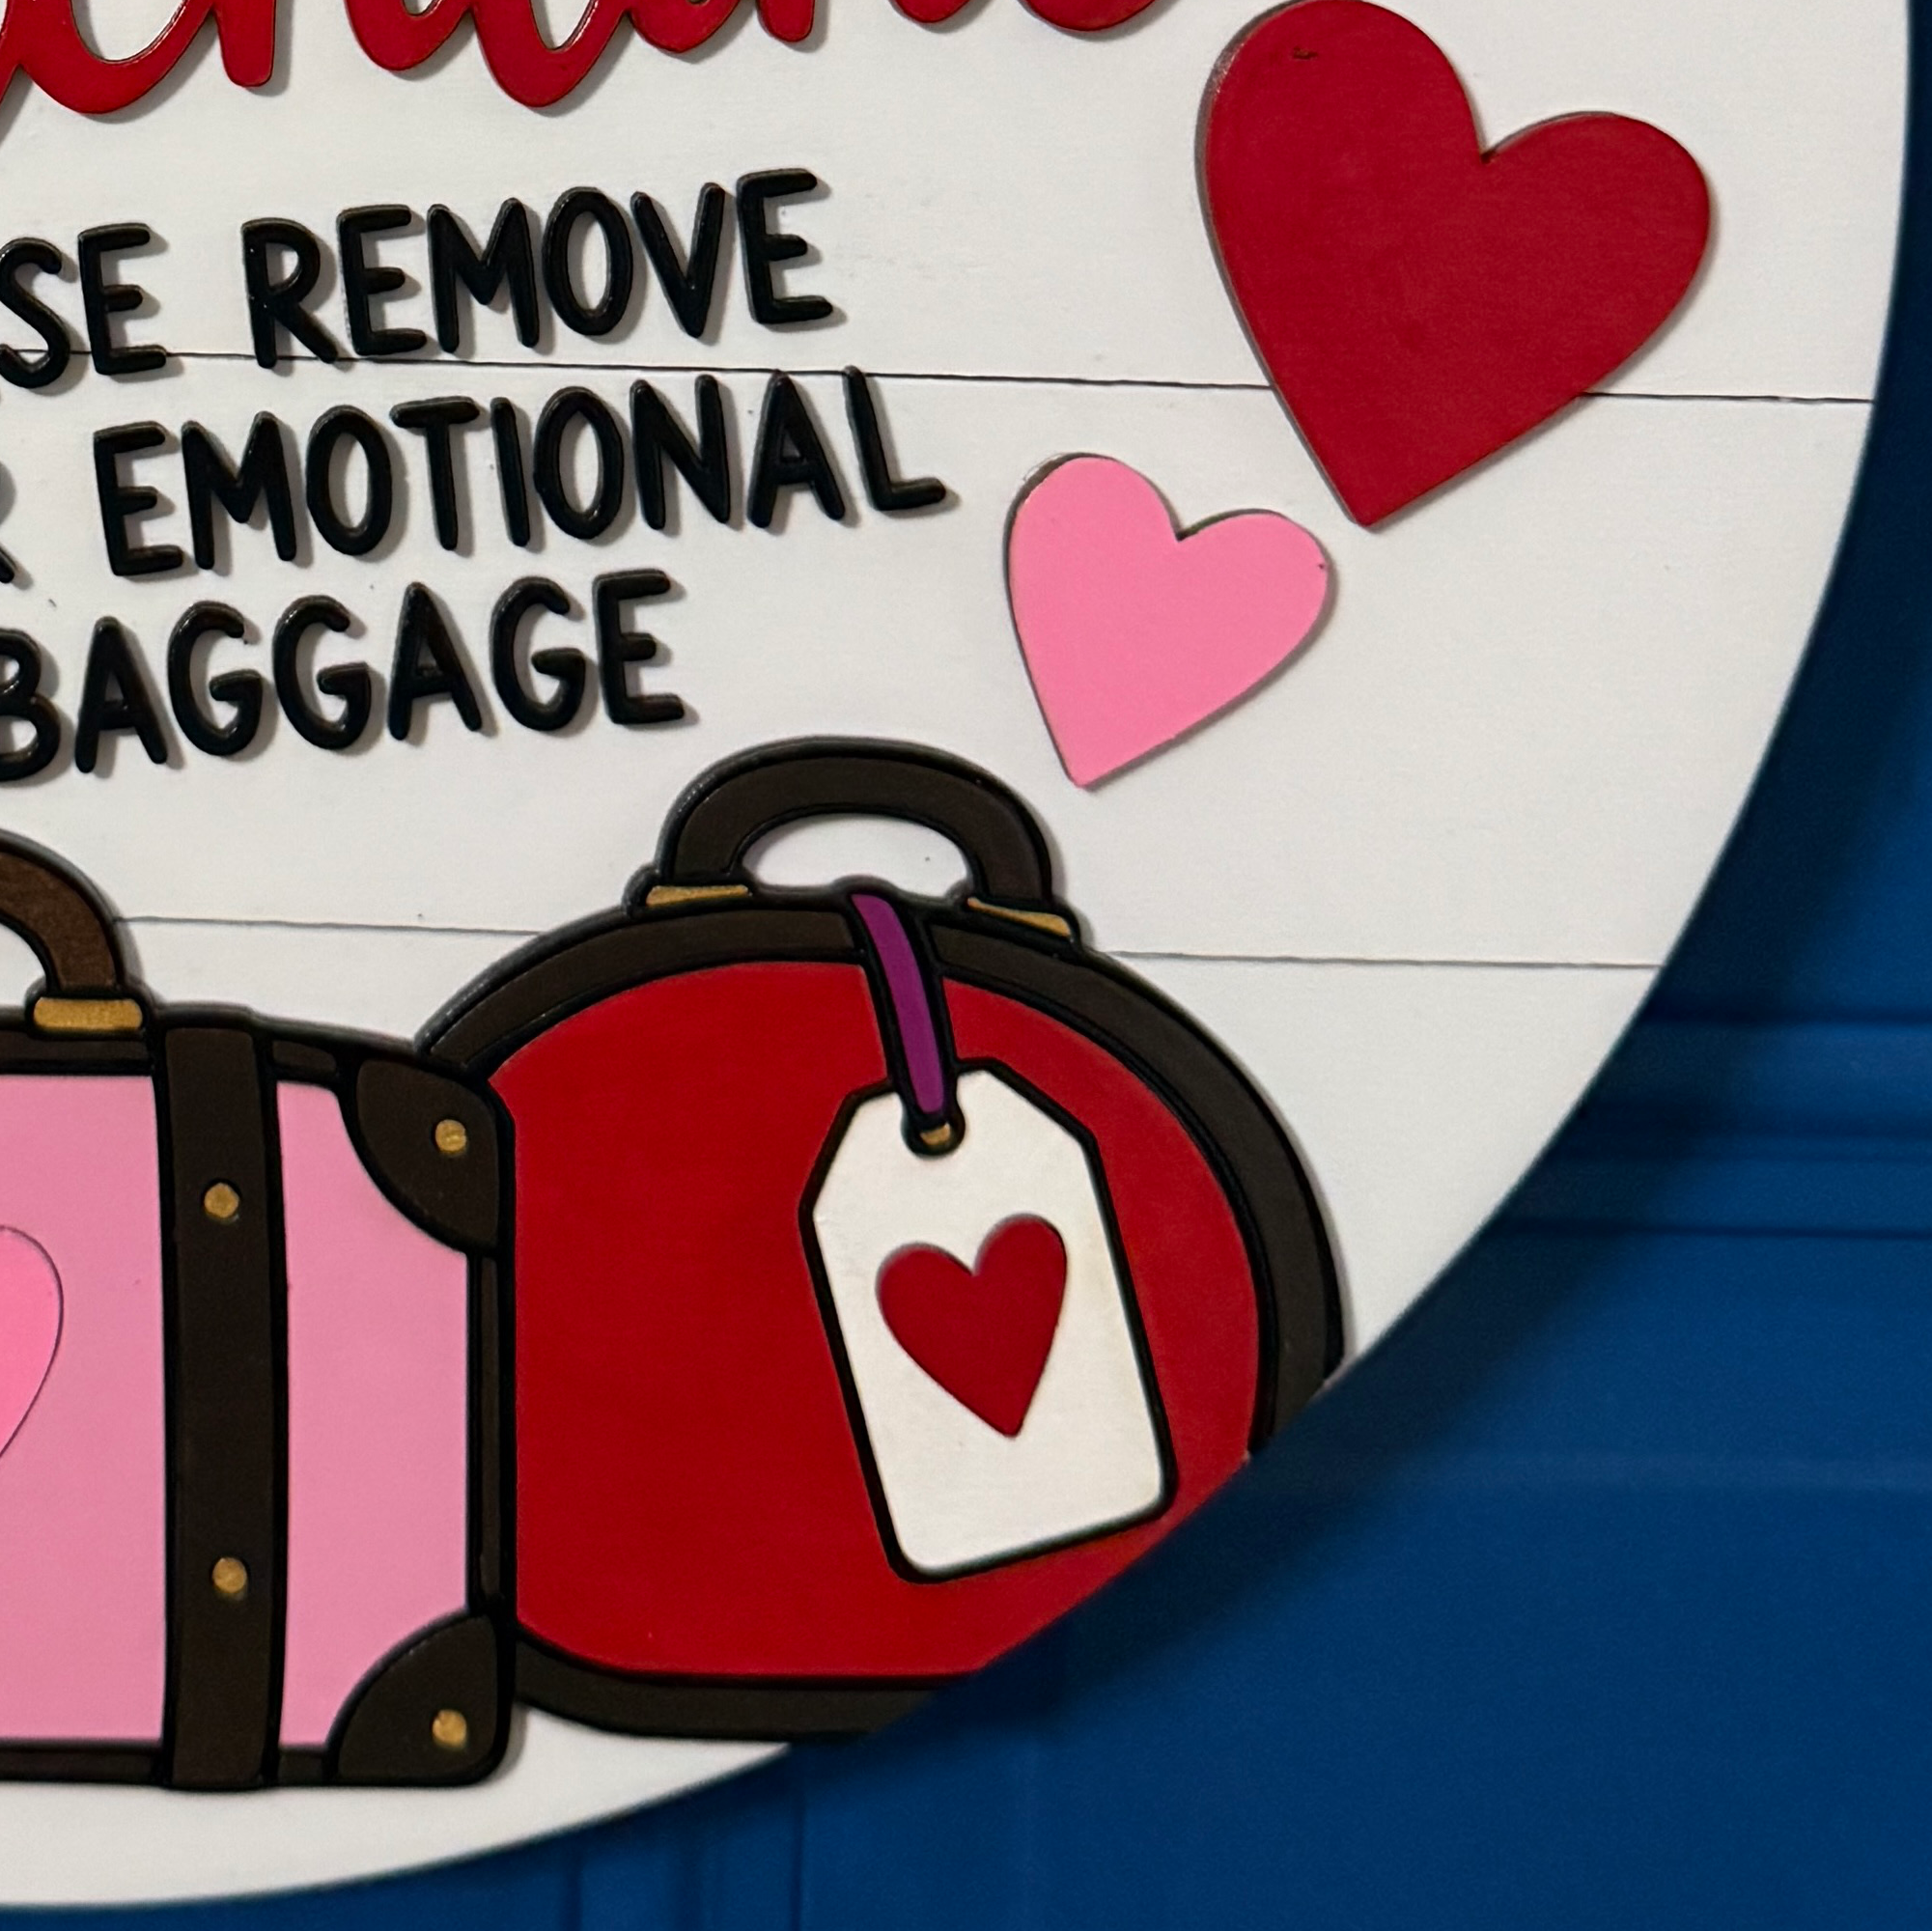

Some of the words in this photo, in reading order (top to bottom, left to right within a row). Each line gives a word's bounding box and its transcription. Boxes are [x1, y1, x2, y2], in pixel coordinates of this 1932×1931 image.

[241, 170, 834, 369] REMOVE
[94, 366, 946, 577] EMOTIONAL
[0, 570, 686, 785] BAGGAGE
